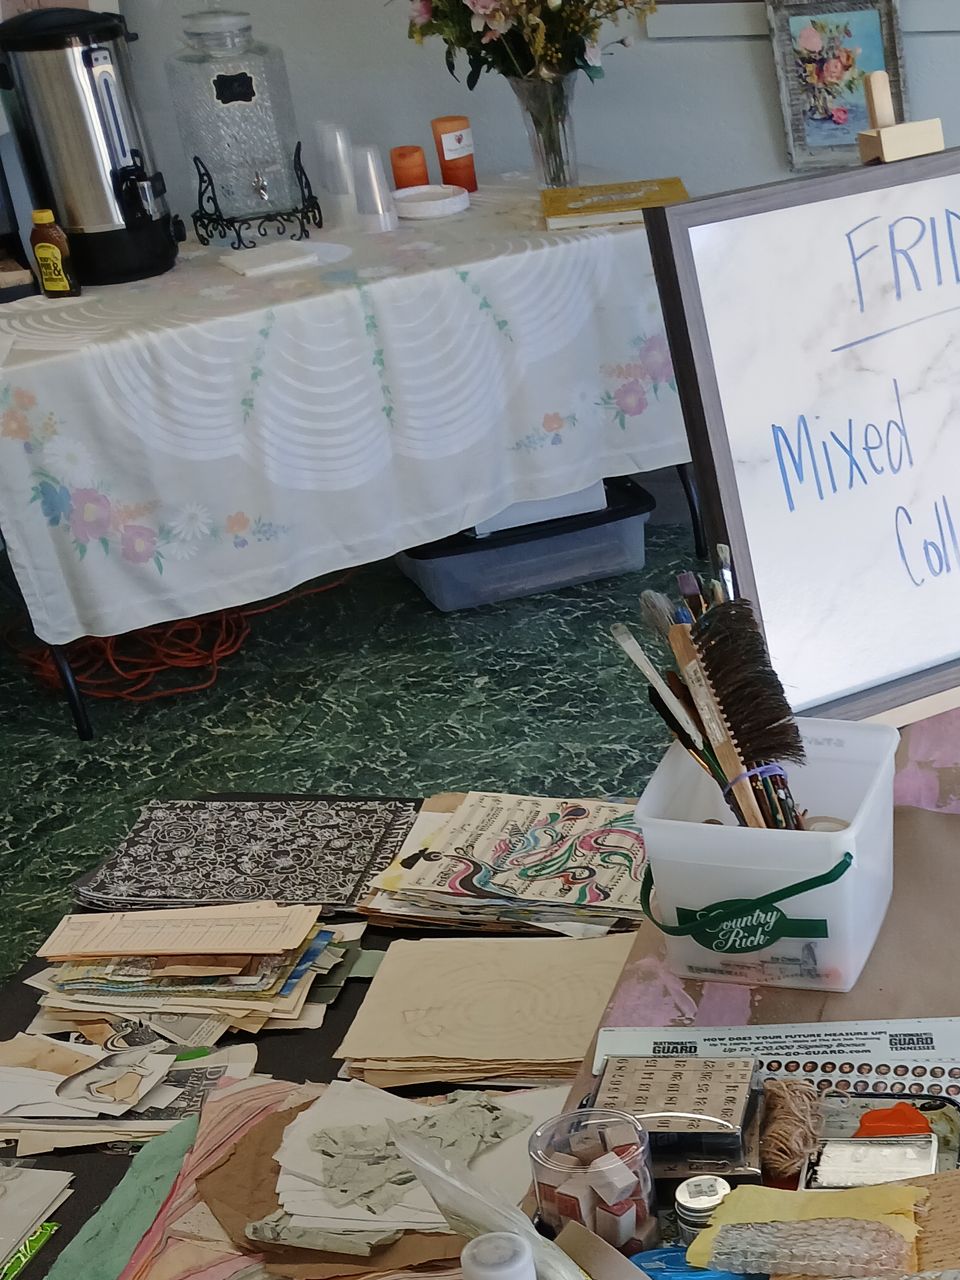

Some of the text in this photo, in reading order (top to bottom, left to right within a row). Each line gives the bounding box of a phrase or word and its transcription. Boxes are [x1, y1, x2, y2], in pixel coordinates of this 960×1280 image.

[771, 379, 914, 513] Mixed
[712, 927, 771, 952] Rich
[888, 1036, 934, 1046] GUARD
[652, 1045, 698, 1054] GUARD
[644, 1059, 658, 1068] 15
[674, 1060, 687, 1068] 21
[703, 1060, 717, 1069] 27
[641, 1072, 655, 1080] 14
[670, 1071, 684, 1081] 20
[700, 1071, 713, 1081] 26
[637, 1083, 651, 1092] 13
[667, 1083, 681, 1092] 19
[696, 1083, 710, 1093] 25
[725, 1085, 739, 1093] 31
[635, 1095, 649, 1105] 12
[664, 1096, 678, 1105] 18
[694, 1097, 708, 1106] 24
[724, 1096, 737, 1106] 30
[721, 1108, 734, 1118] 29
